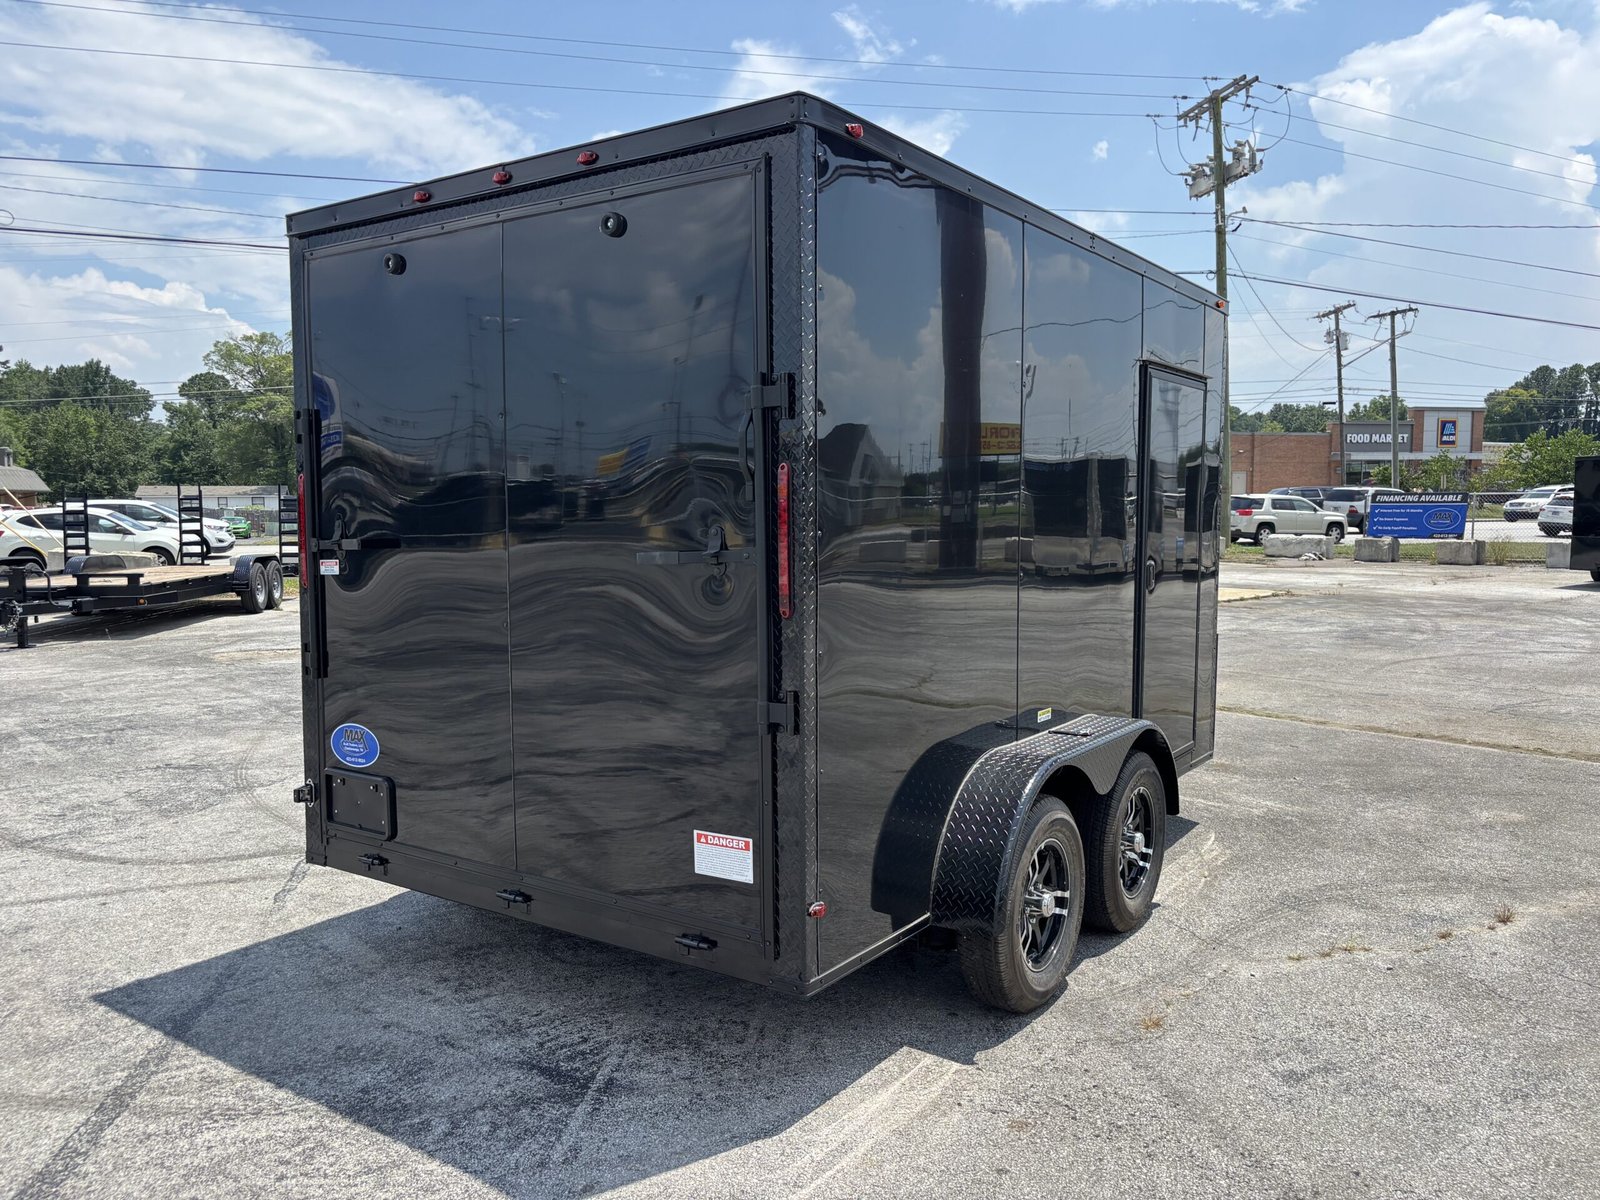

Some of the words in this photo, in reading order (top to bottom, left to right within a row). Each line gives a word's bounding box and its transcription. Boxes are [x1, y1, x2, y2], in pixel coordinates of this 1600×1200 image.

[1347, 433, 1370, 443] FOOD
[1372, 433, 1408, 443] MARET
[1419, 494, 1463, 502] AVAILABLE
[1433, 512, 1454, 521] MAX
[344, 728, 368, 745] MAX
[708, 836, 746, 850] DANGER
